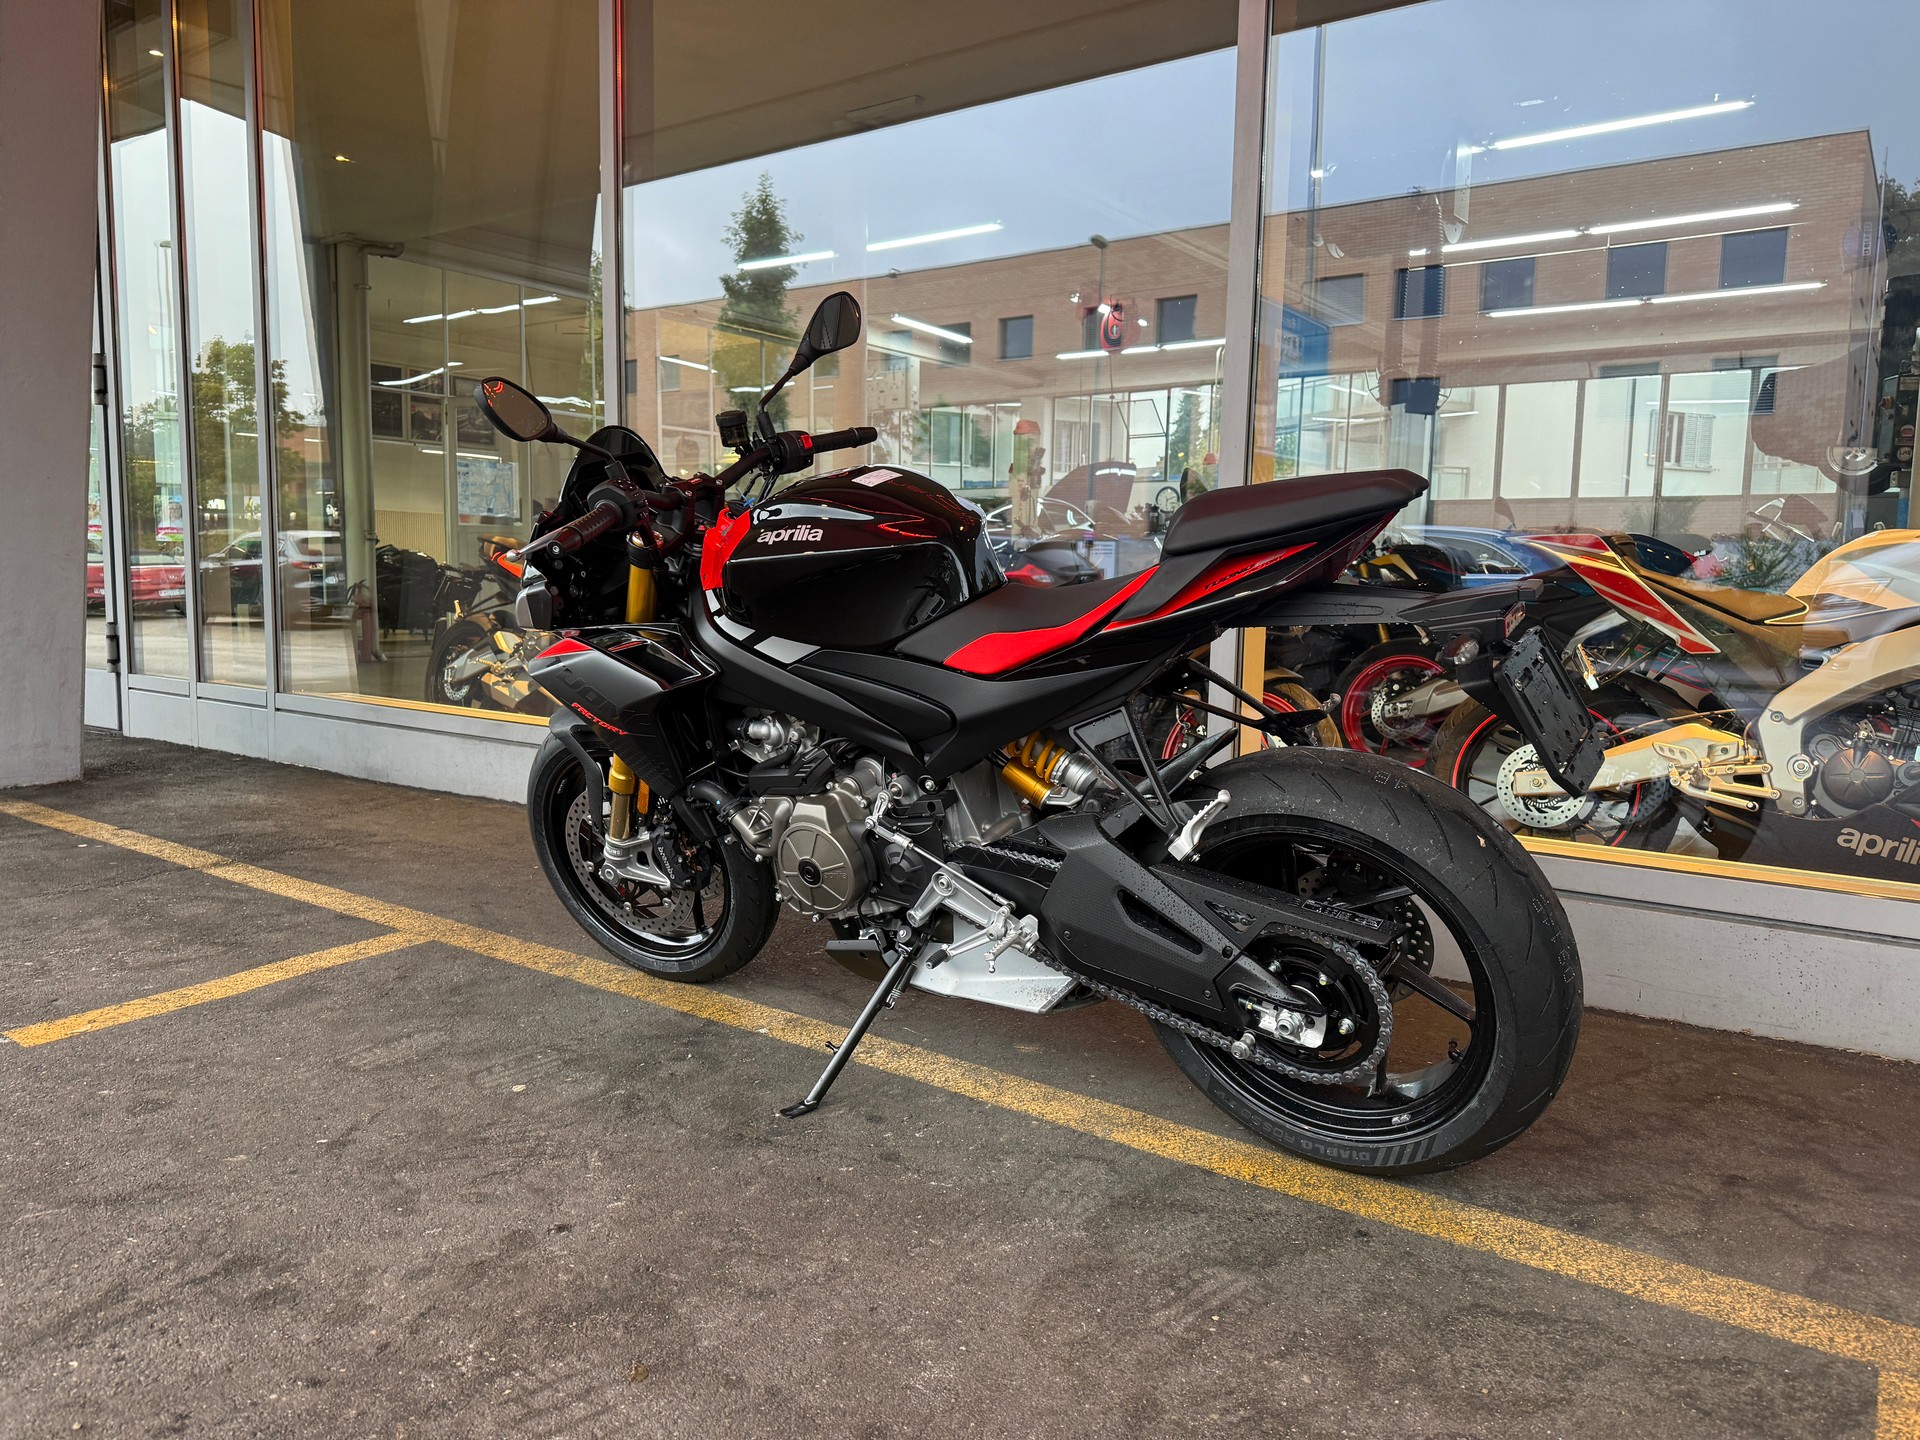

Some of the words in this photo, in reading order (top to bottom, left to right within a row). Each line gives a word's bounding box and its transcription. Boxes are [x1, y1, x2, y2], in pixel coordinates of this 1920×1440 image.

[757, 525, 823, 545] aprilia
[1204, 563, 1255, 590] TUONO
[571, 702, 629, 736] FACTORY
[657, 846, 676, 880] brembo
[1837, 827, 1920, 865] aprili
[1240, 1109, 1295, 1144] ROSSO
[1300, 1139, 1371, 1162] DIABLO
